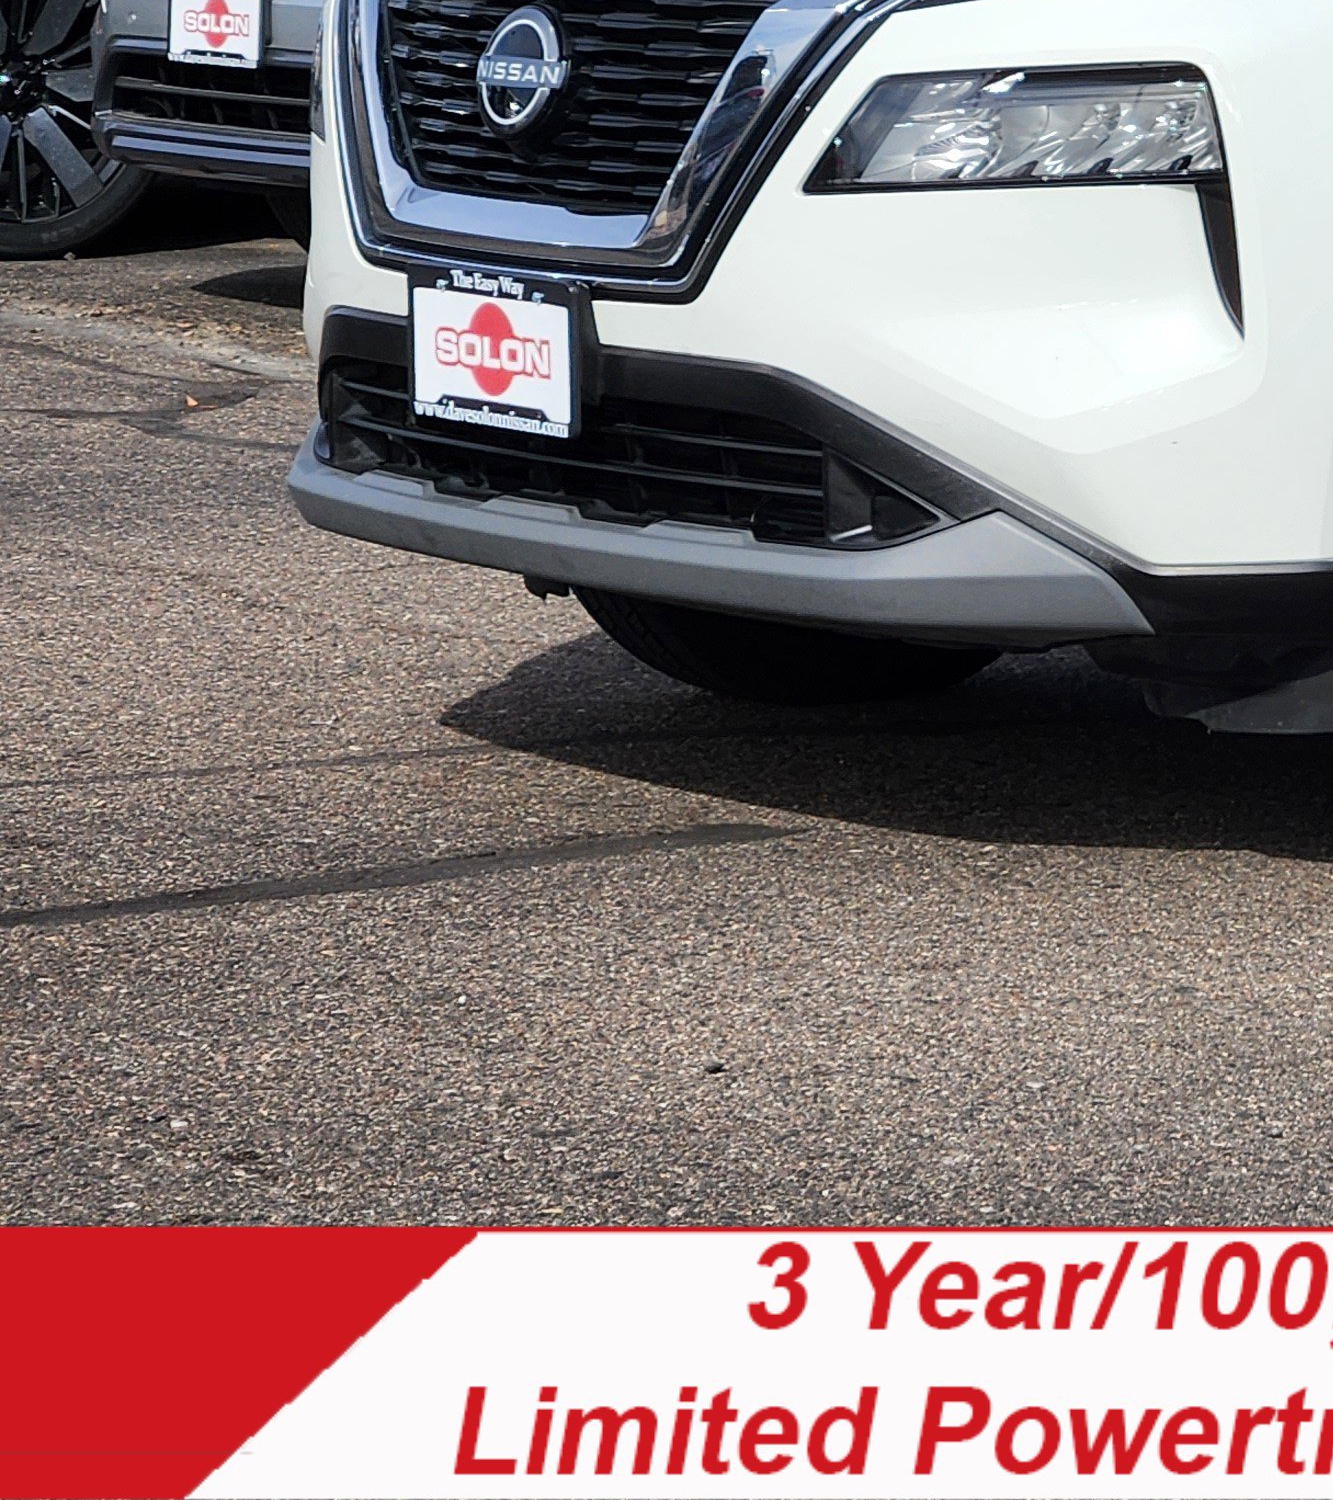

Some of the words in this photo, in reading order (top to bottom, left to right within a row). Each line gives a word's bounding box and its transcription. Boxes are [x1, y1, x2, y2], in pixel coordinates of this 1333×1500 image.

[184, 9, 250, 37] SOLON
[478, 59, 561, 85] NISSAN
[450, 269, 473, 288] The
[472, 272, 500, 297] Easy
[498, 275, 525, 300] Way
[435, 327, 552, 380] SOLON
